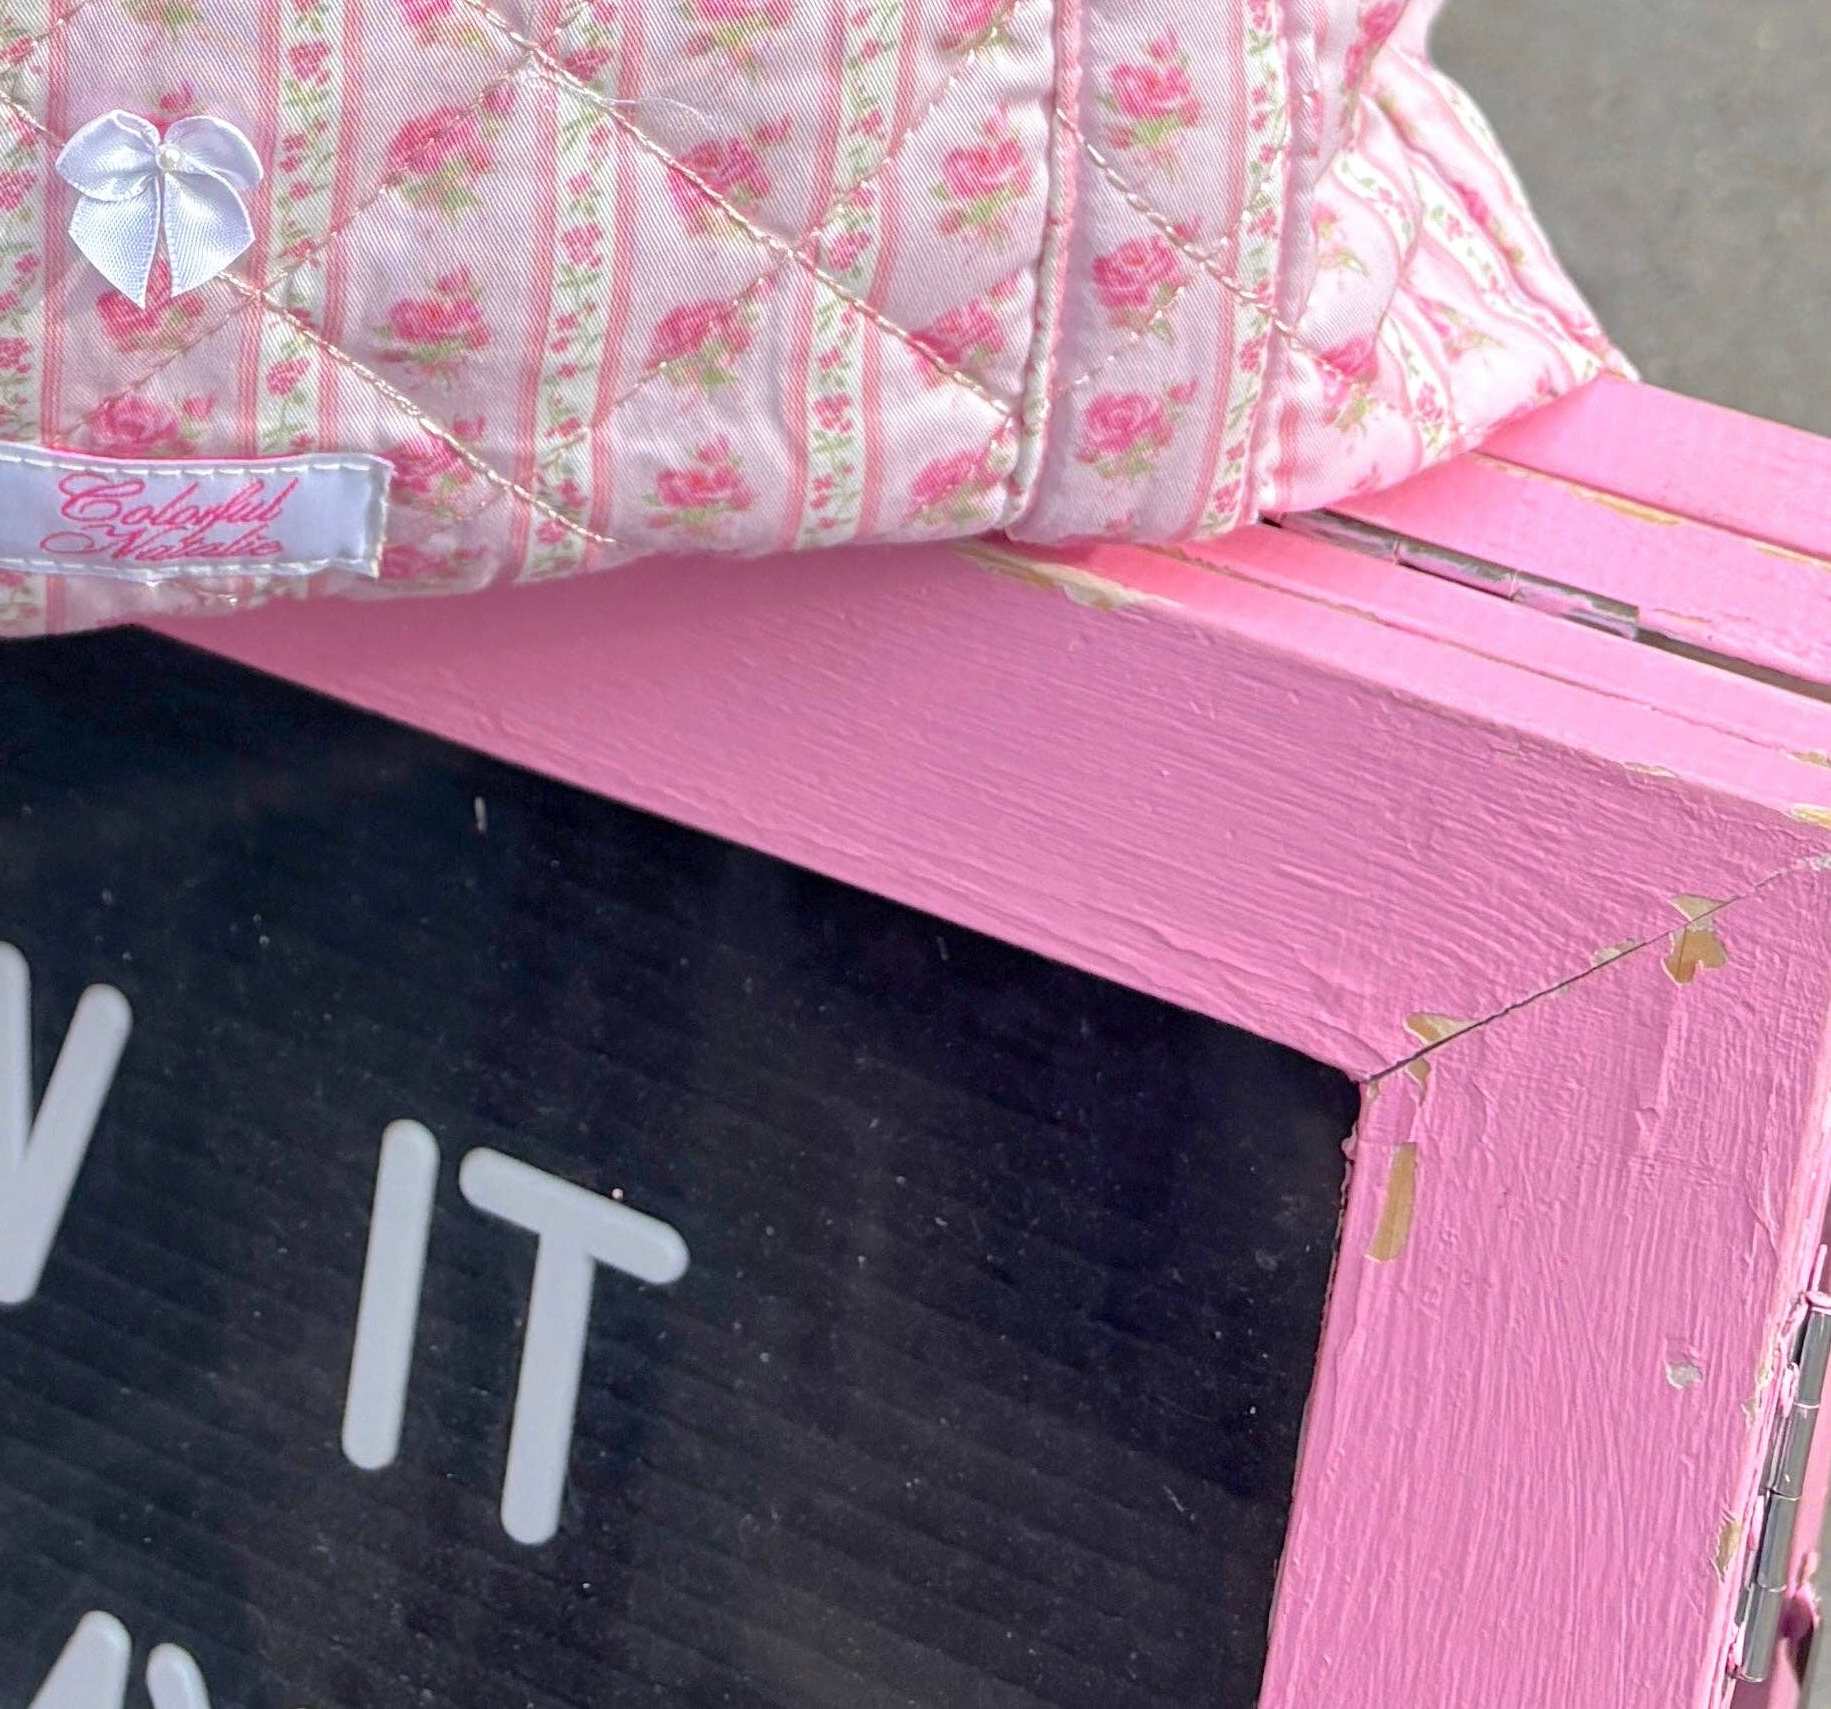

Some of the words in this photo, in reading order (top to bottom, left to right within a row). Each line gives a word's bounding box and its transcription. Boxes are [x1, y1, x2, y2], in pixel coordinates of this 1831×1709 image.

[57, 473, 298, 526] Colorful
[39, 523, 283, 562] Natalie
[342, 1120, 689, 1545] IT
